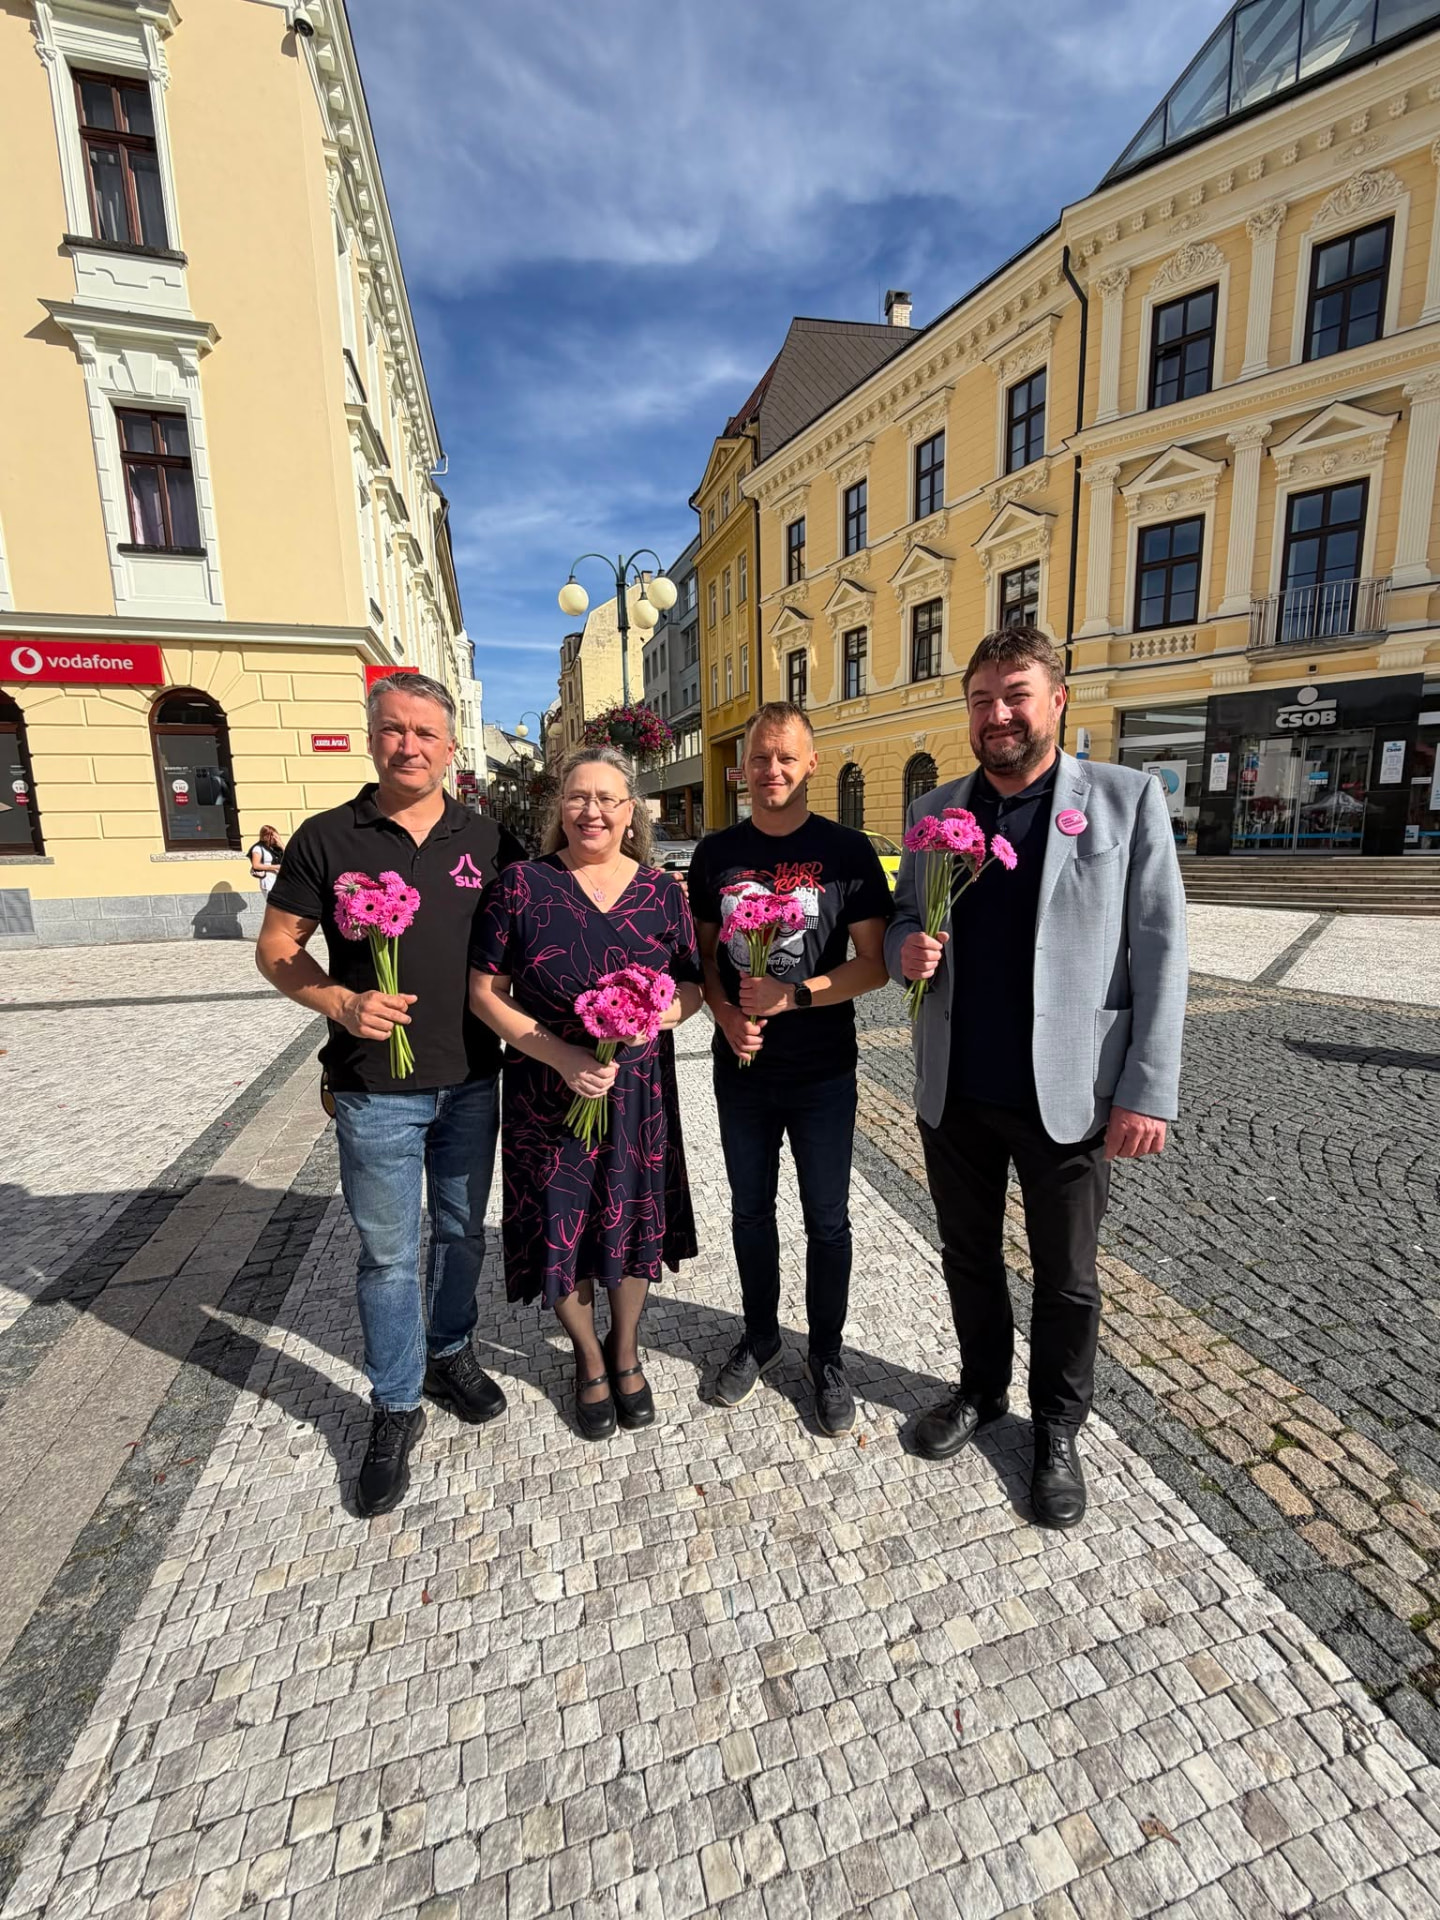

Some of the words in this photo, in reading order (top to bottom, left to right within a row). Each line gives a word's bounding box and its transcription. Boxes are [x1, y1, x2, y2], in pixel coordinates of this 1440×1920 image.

[46, 653, 134, 670] vodafone
[1275, 710, 1337, 729] ČSOB
[774, 861, 824, 880] HARD
[454, 875, 483, 890] SLK
[773, 874, 826, 895] ROCK
